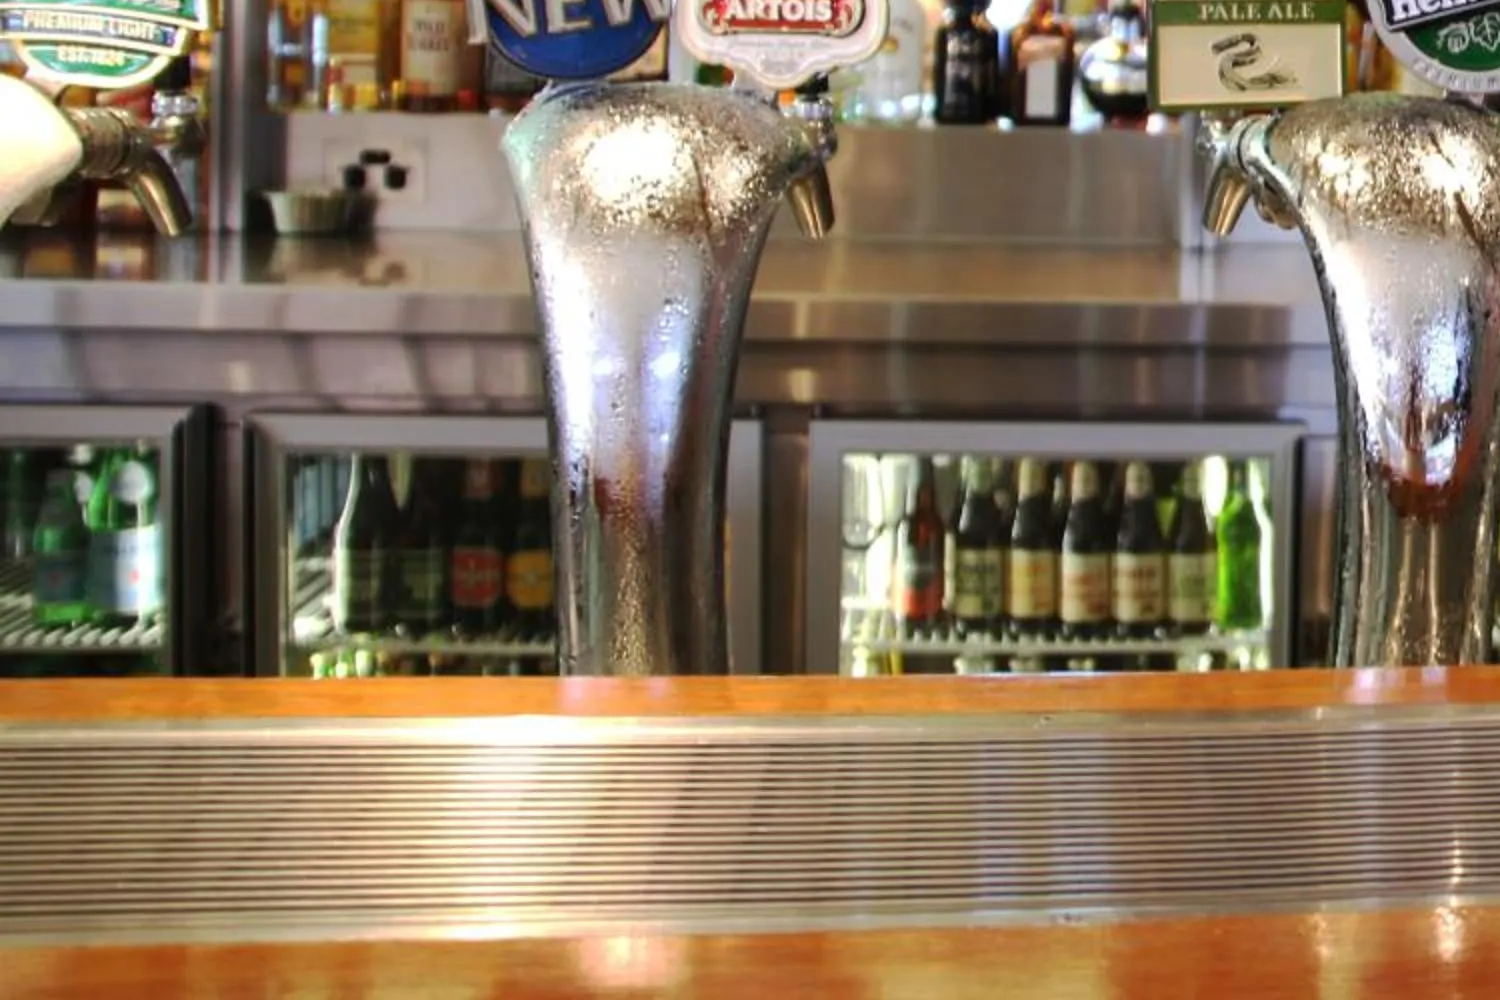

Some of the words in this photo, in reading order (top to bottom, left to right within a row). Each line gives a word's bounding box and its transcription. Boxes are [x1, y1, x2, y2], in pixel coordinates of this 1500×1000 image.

[1198, 2, 1261, 21] PALE
[1267, 2, 1316, 20] ALE
[23, 9, 103, 31] PREMIUM
[109, 20, 156, 40] LIGHT
